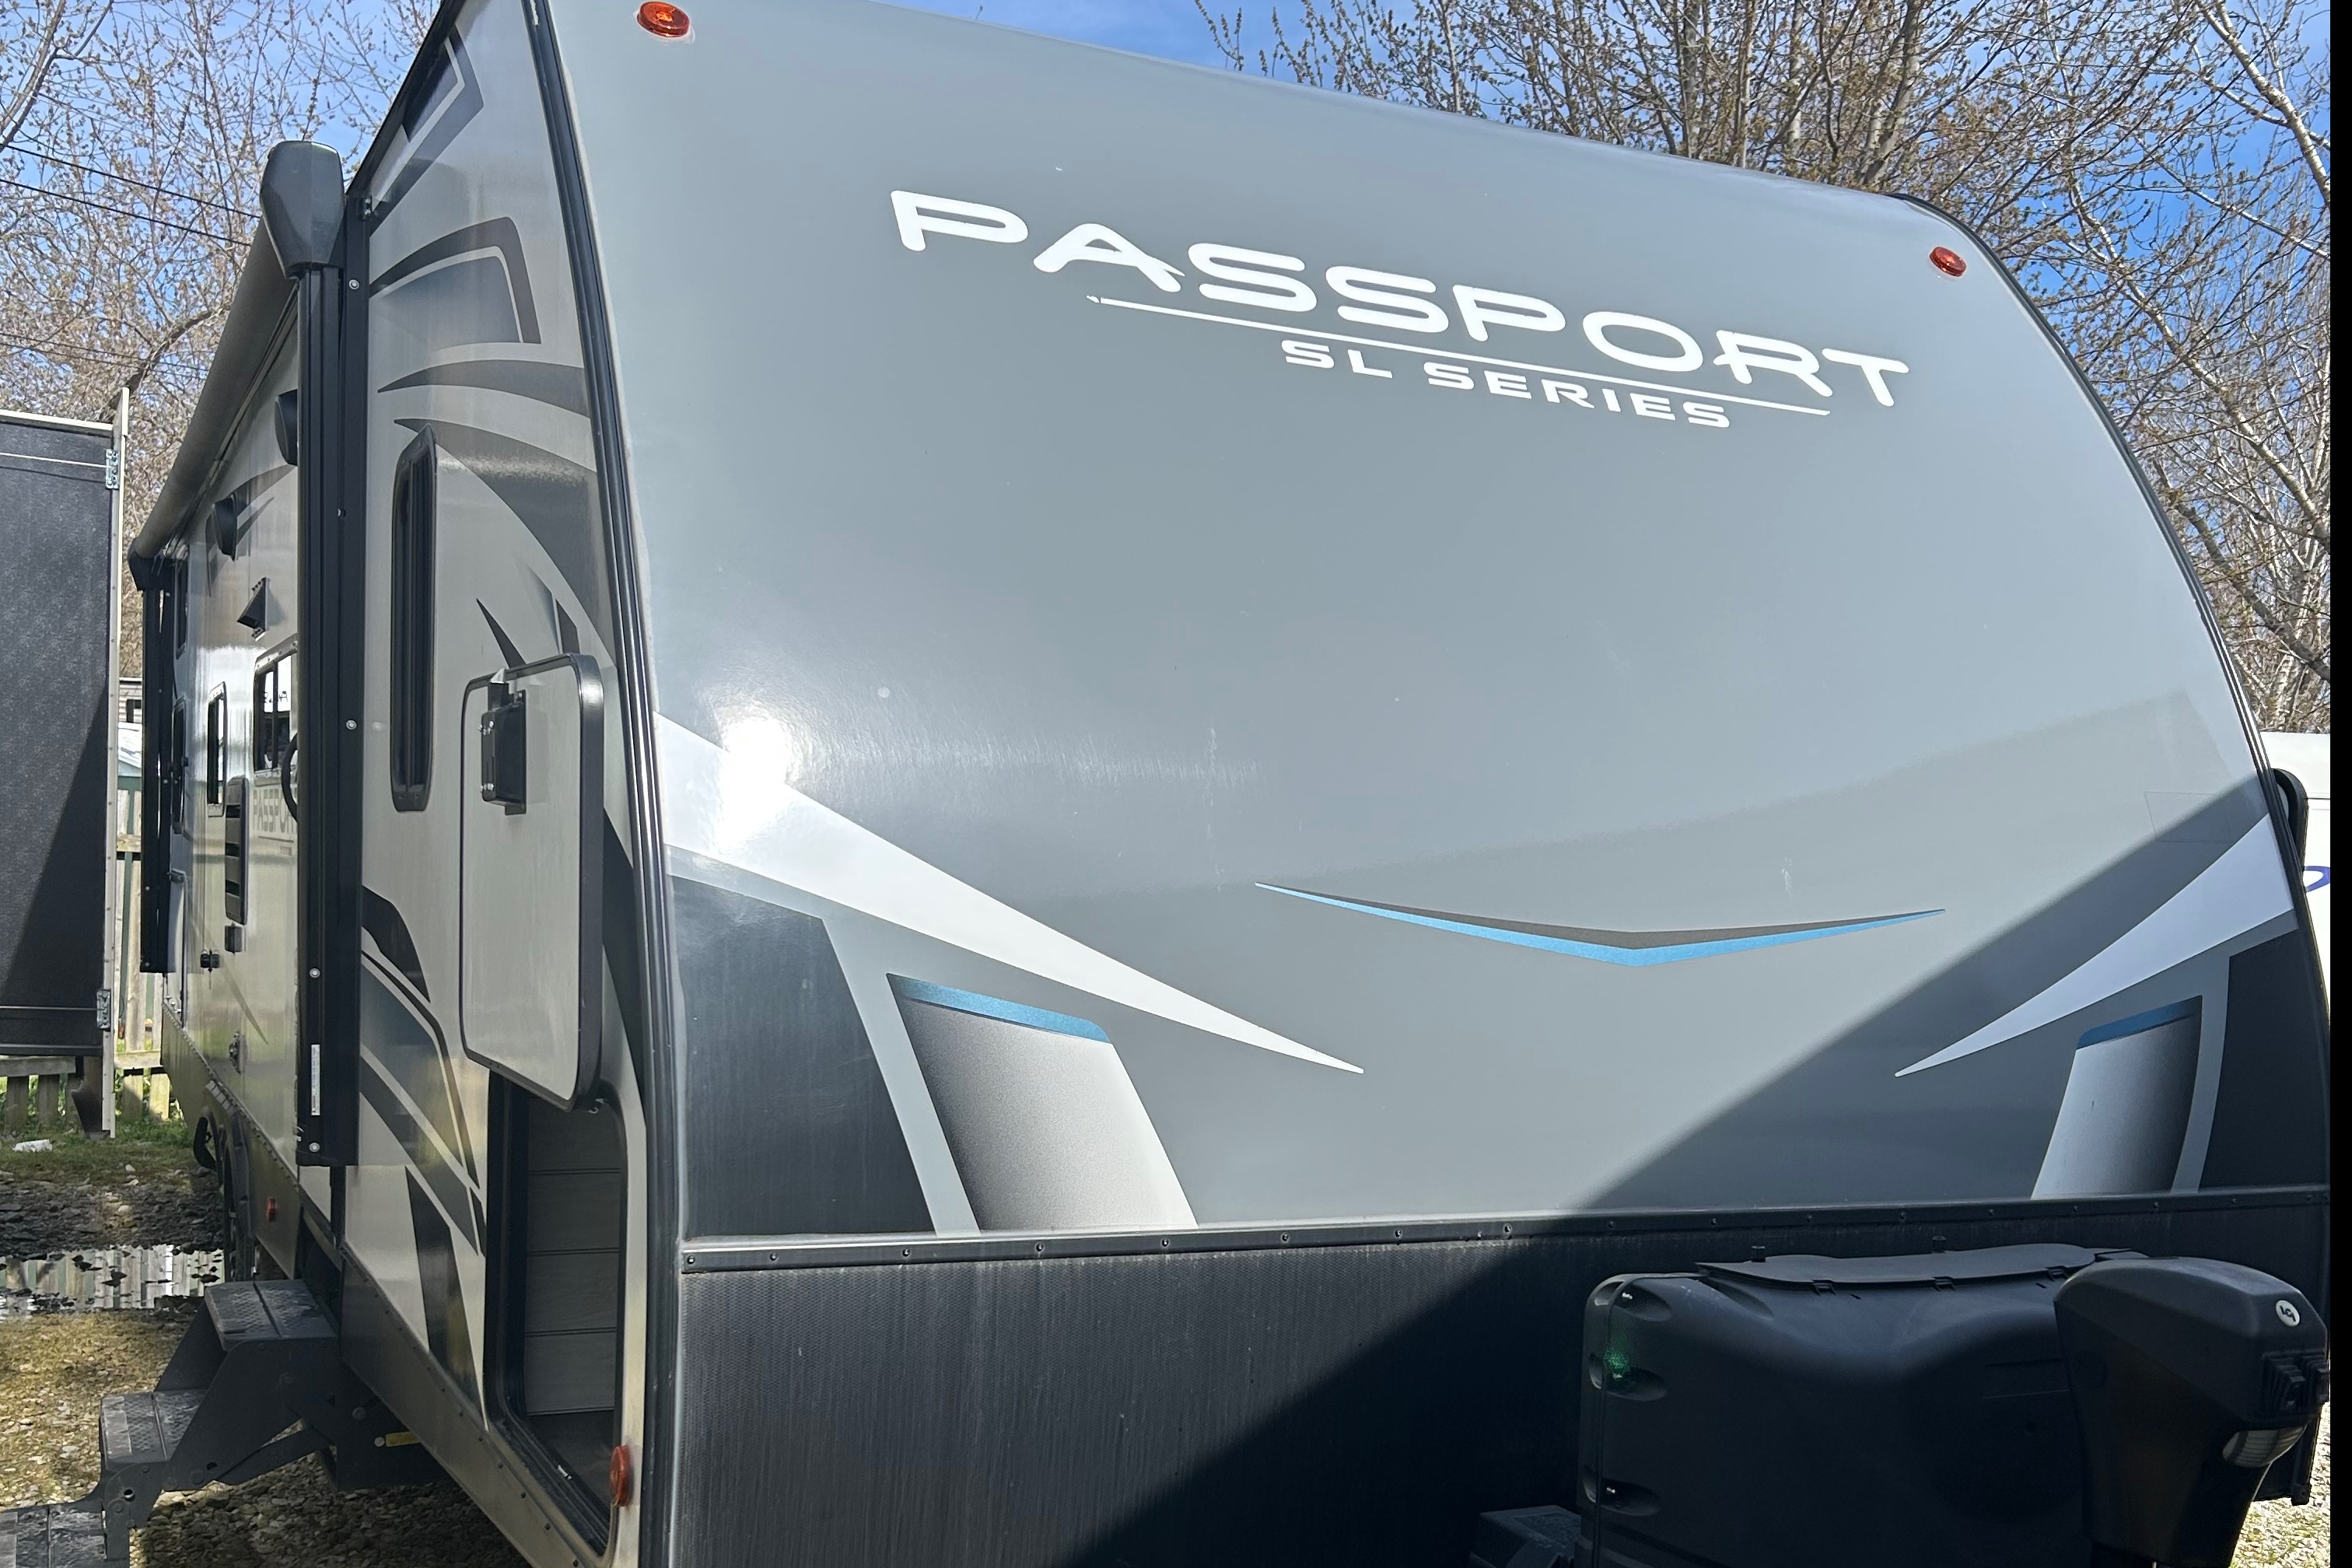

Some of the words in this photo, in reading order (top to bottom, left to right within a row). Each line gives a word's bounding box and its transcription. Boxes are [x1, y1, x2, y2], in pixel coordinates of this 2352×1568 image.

[890, 189, 1910, 408] PASSPORT
[1280, 339, 1394, 380] SL
[1423, 361, 1731, 429] SERIES
